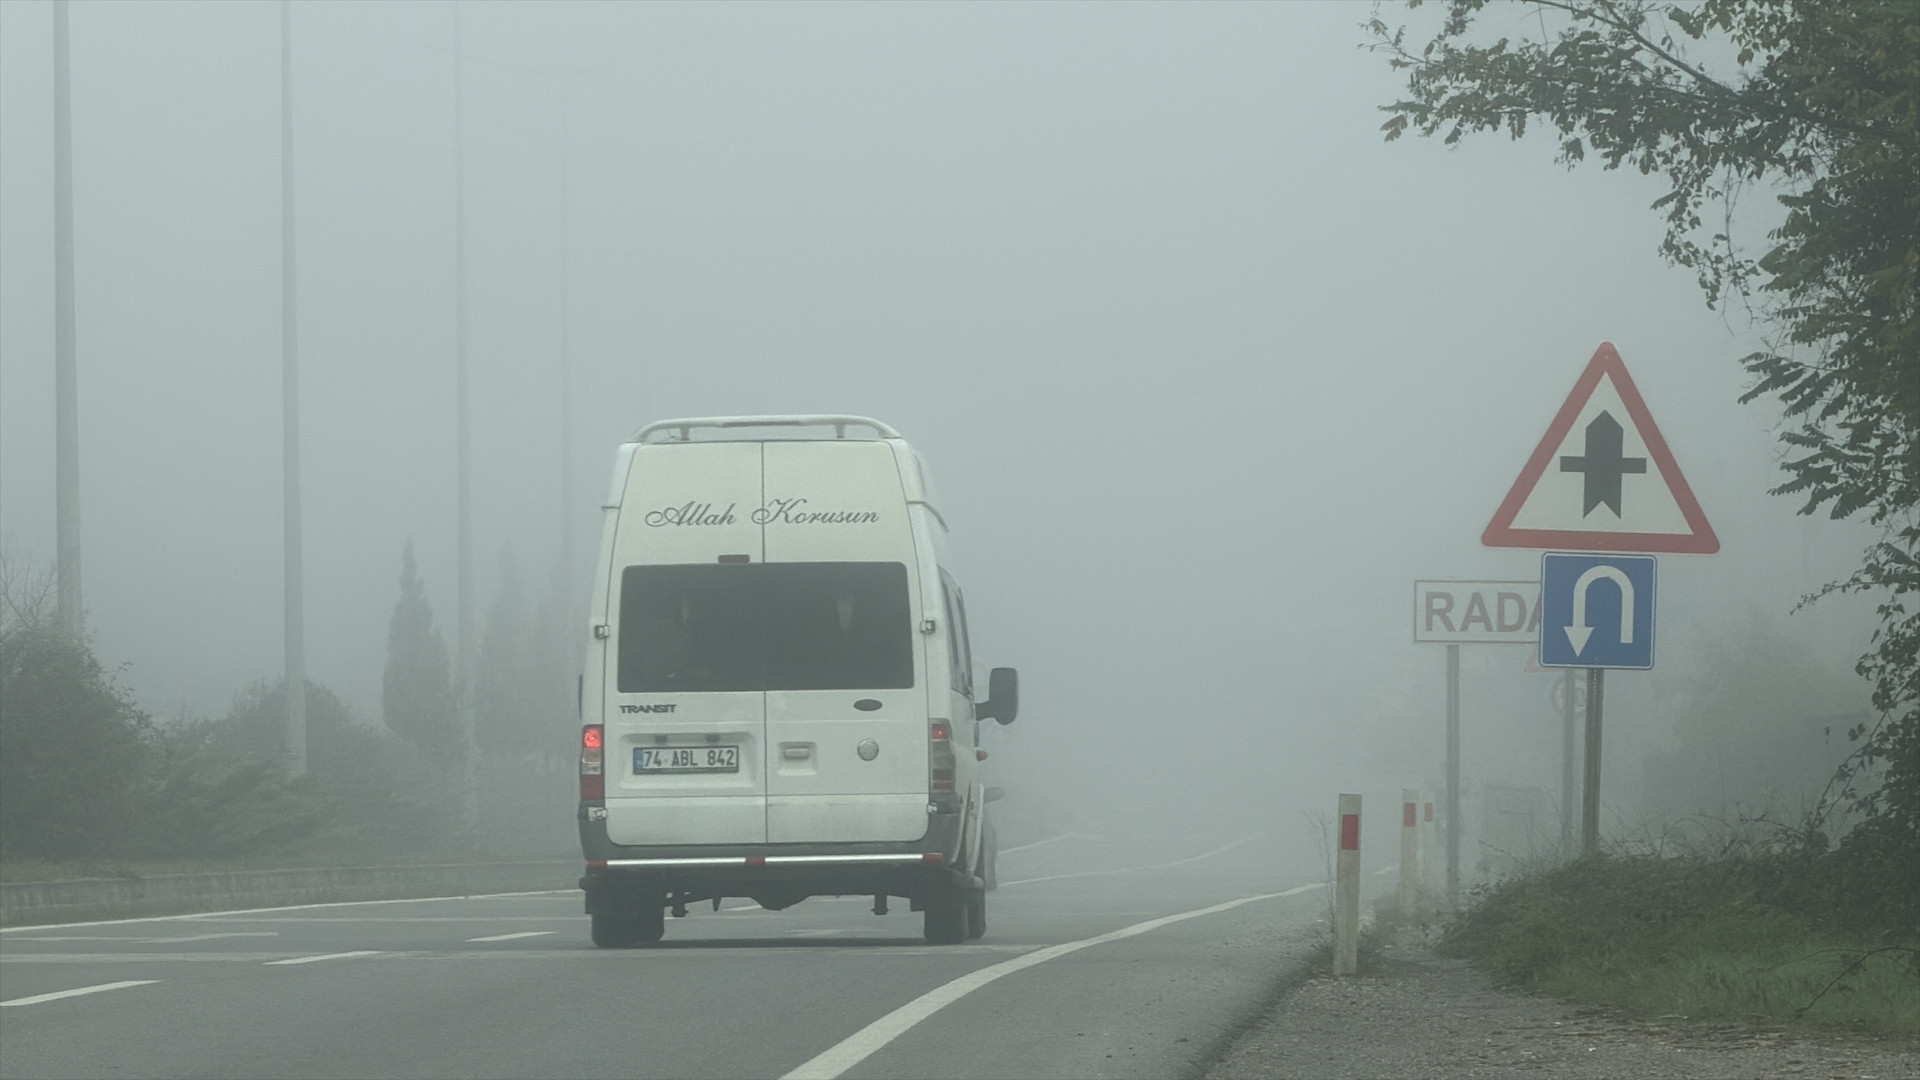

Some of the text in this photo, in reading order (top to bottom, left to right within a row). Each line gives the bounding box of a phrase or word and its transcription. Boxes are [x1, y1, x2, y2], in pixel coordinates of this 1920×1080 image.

[645, 497, 880, 528] Allah Korusun
[619, 704, 677, 714] TRANSIT
[644, 749, 735, 767] 74 ABL 842
